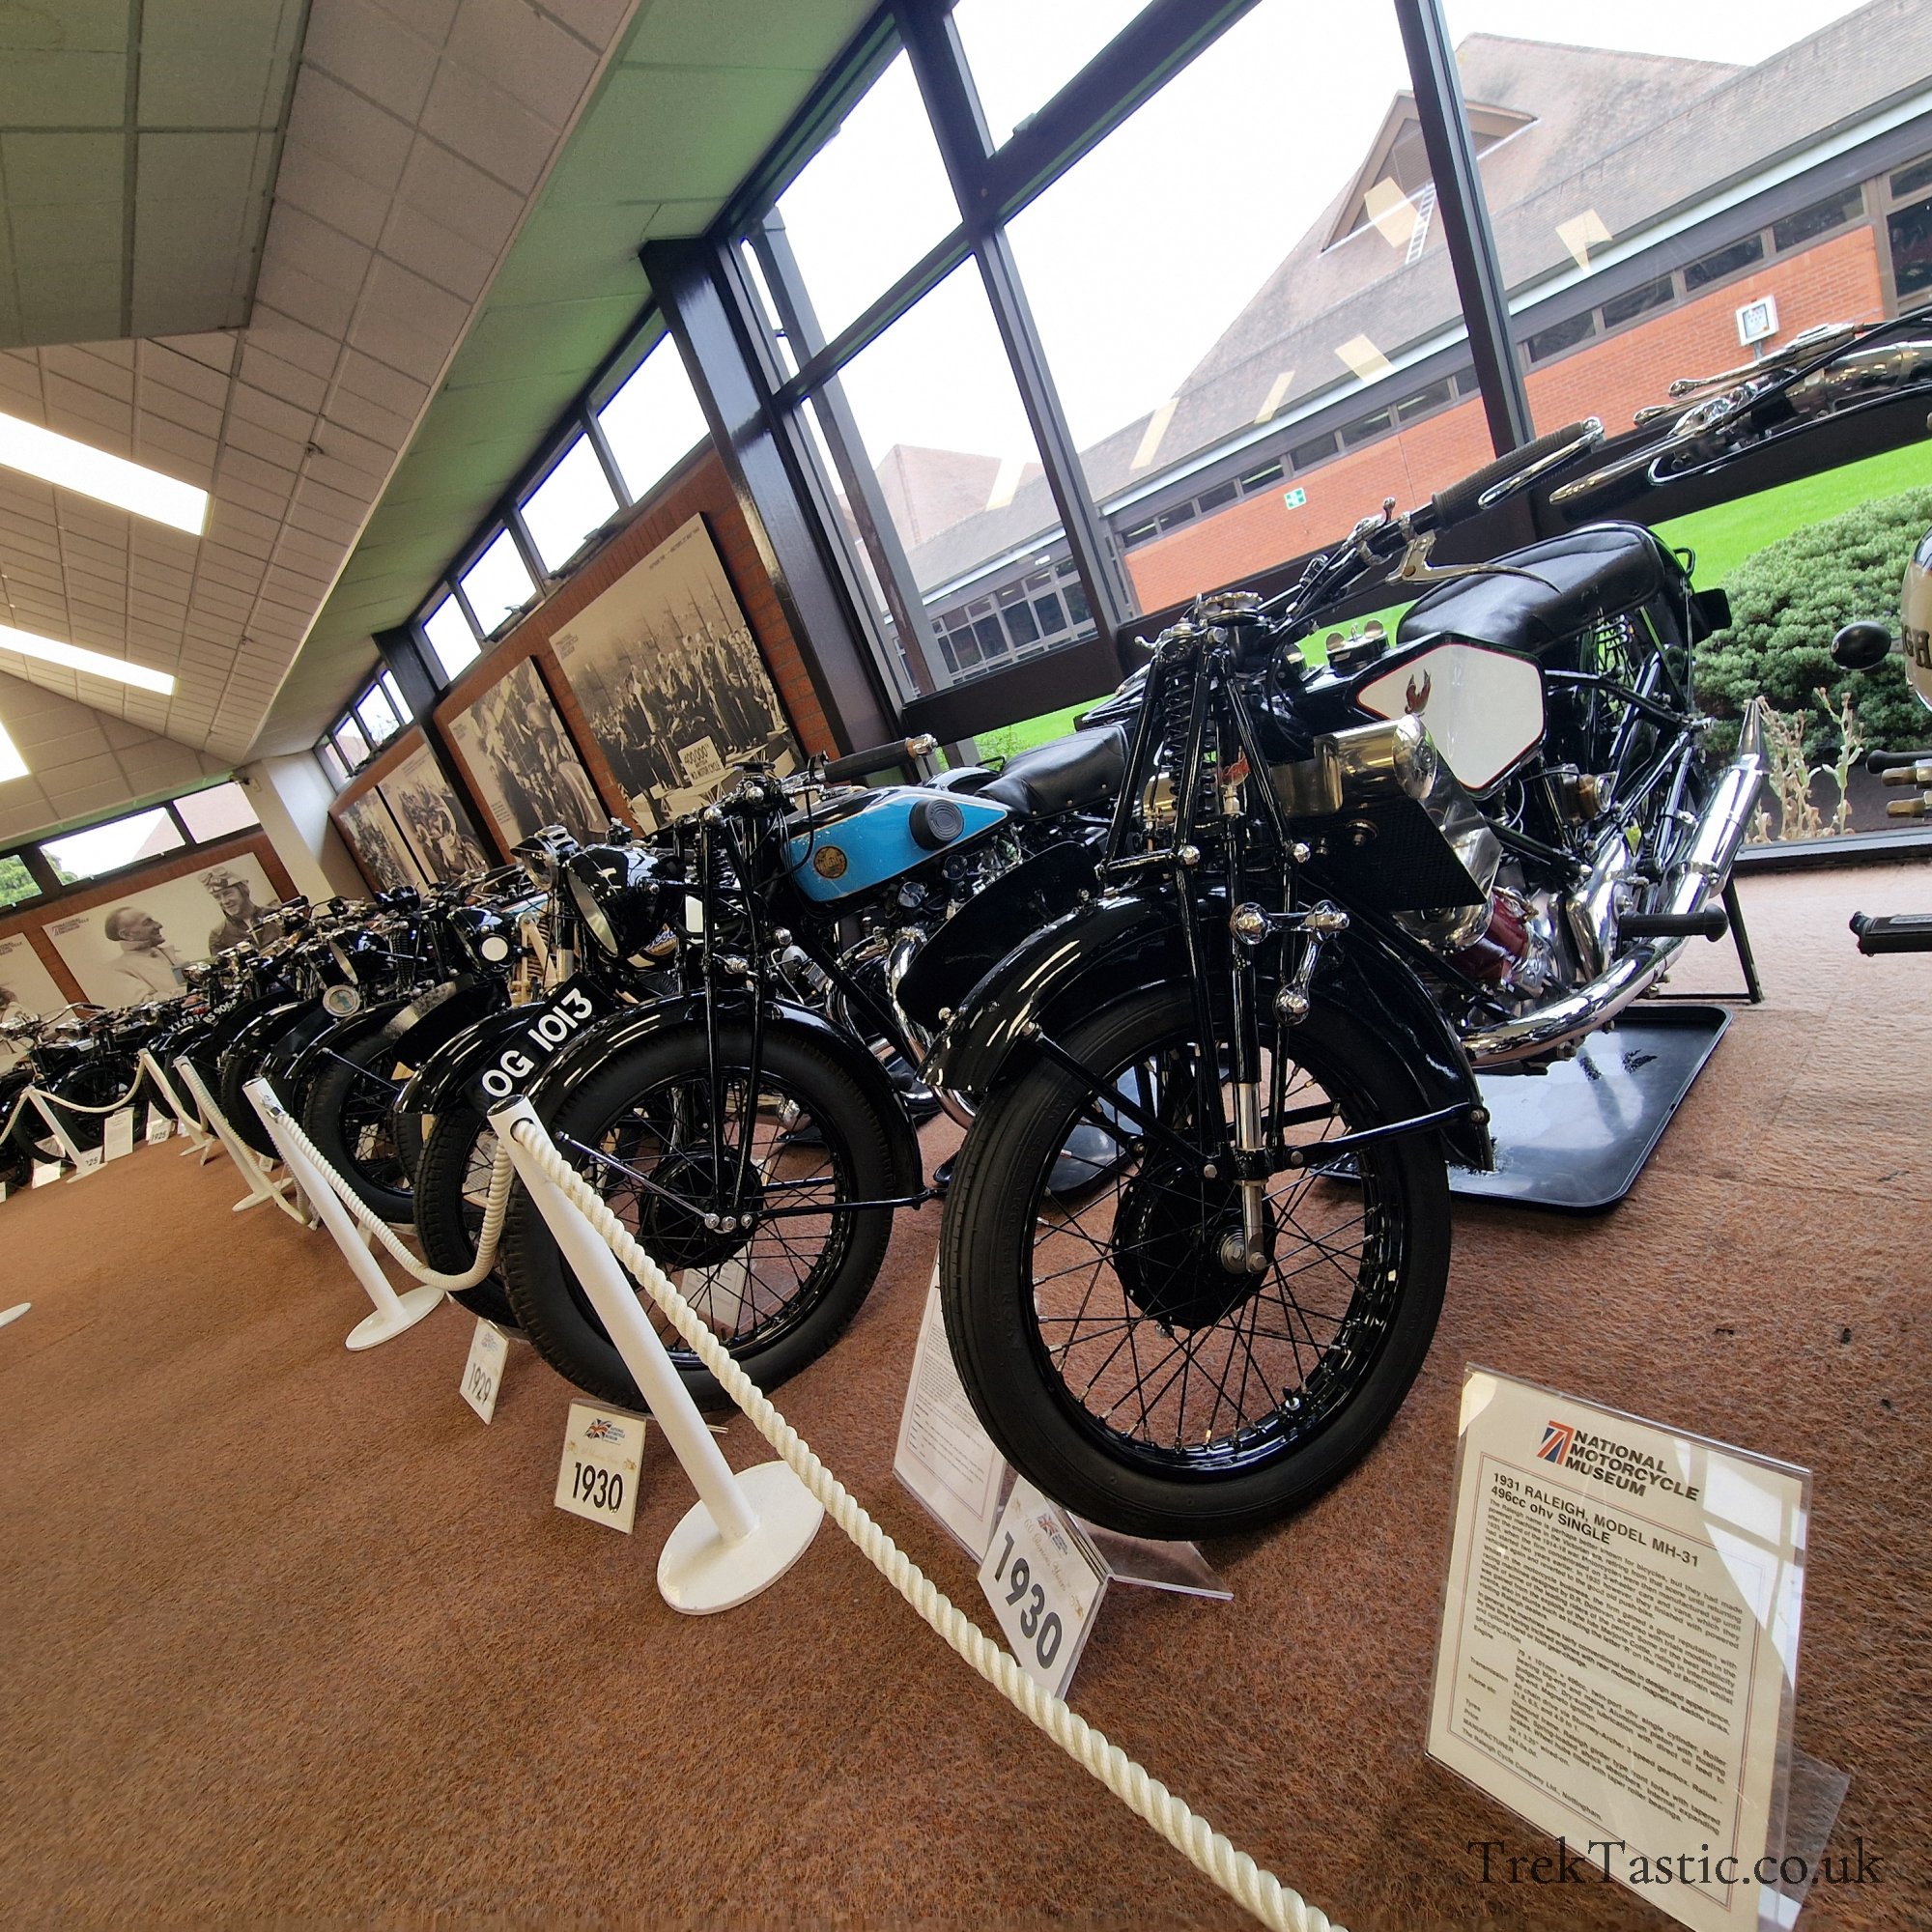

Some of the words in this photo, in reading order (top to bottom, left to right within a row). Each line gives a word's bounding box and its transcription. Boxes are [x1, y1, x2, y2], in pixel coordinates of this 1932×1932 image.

[481, 1049, 534, 1097] OG
[527, 987, 592, 1051] 1013
[468, 1362, 492, 1406] 1929
[1565, 1456, 1647, 1497] MUSEUM
[1570, 1443, 1700, 1501] MOTORCYCLE
[1574, 1430, 1667, 1474] NATIONAL
[572, 1462, 623, 1514] 1930
[1491, 1486, 1526, 1508] 496cc
[1529, 1503, 1553, 1520] ohv
[1557, 1513, 1610, 1545] SINGLE
[1493, 1472, 1520, 1492] 1931
[1524, 1485, 1588, 1521] RALEIGH,
[1594, 1513, 1646, 1546] MODEL
[1652, 1538, 1698, 1567] MH-31
[1485, 1536, 1508, 1549] vehicles
[1509, 1548, 1526, 1558] again
[1526, 1555, 1539, 1564] and
[1540, 1561, 1566, 1577] reverted
[1575, 1577, 1585, 1586] the
[1586, 1583, 1605, 1596] good
[1605, 1592, 1617, 1602] old
[1488, 1507, 1512, 1520] powered
[1514, 1519, 1541, 1534] machines
[1562, 1538, 1589, 1555] Victorian
[1605, 1559, 1629, 1574] retiring
[1631, 1569, 1647, 1580] from
[1649, 1577, 1662, 1588] that
[1664, 1585, 1686, 1598] scene
[1688, 1596, 1704, 1606] until
[1707, 1604, 1742, 1625] returning
[1488, 1514, 1500, 1522] after
[1511, 1524, 1522, 1533] end
[1543, 1538, 1566, 1552] 1914-18
[1623, 1575, 1639, 1586] were
[1640, 1582, 1657, 1594] then
[1658, 1591, 1710, 1618] manufactured
[1722, 1620, 1741, 1632] until
[1490, 1498, 1500, 1507] The
[1501, 1504, 1523, 1518] Raleigh
[1525, 1515, 1542, 1525] name
[1551, 1526, 1577, 1541] perhaps
[1578, 1538, 1598, 1549] better
[1600, 1547, 1622, 1561] known
[1624, 1557, 1634, 1566] for
[1670, 1577, 1683, 1588] but
[1685, 1584, 1701, 1597] they
[1703, 1592, 1719, 1604] had
[1720, 1601, 1743, 1614] made
[1503, 1529, 1520, 1539] when
[1521, 1536, 1531, 1545] the
[1533, 1542, 1546, 1551] firm
[1548, 1549, 1589, 1572] concentrated
[1603, 1573, 1635, 1592] 3-wheeler
[1638, 1590, 1654, 1602] cars
[1657, 1599, 1670, 1608] and
[1696, 1617, 1719, 1631] which
[1722, 1628, 1740, 1641] they
[994, 1531, 1063, 1669] 1930
[1486, 1527, 1496, 1536] had
[1498, 1534, 1519, 1547] started
[1520, 1544, 1531, 1553] two
[1534, 1551, 1550, 1562] years
[1585, 1574, 1600, 1585] 1935
[1635, 1597, 1651, 1609] they
[1654, 1605, 1684, 1624] finished
[1686, 1621, 1702, 1633] with
[1704, 1630, 1739, 1649] powered
[1522, 1564, 1557, 1584] motorcycle
[1593, 1597, 1604, 1605] the
[1605, 1603, 1620, 1614] firm
[1622, 1611, 1646, 1627] gained
[1656, 1628, 1675, 1640] good
[1678, 1638, 1717, 1661] reputation
[1719, 1658, 1737, 1669] with
[1473, 1624, 1493, 1639] Engine
[1475, 1615, 1521, 1644] SPECIFICATION
[1467, 1673, 1486, 1689] Frame
[1487, 1686, 1496, 1694] etc
[1470, 1656, 1508, 1683] Transmission
[1463, 1708, 1479, 1720] Price
[1465, 1698, 1481, 1712] Tyres
[1462, 1727, 1472, 1738] The
[1474, 1735, 1495, 1753] Raleigh
[1496, 1749, 1514, 1765] Cycle
[1515, 1761, 1544, 1785] Company
[1463, 1718, 1514, 1753] MANUFACTURER
[1513, 1682, 1521, 1690] All
[1523, 1689, 1541, 1701] chain
[1542, 1698, 1558, 1711] drive
[1560, 1709, 1570, 1719] via
[1572, 1715, 1625, 1749] Sturmey-Archer
[1626, 1746, 1655, 1767] 3-speed
[1691, 1783, 1717, 1802] Ratios
